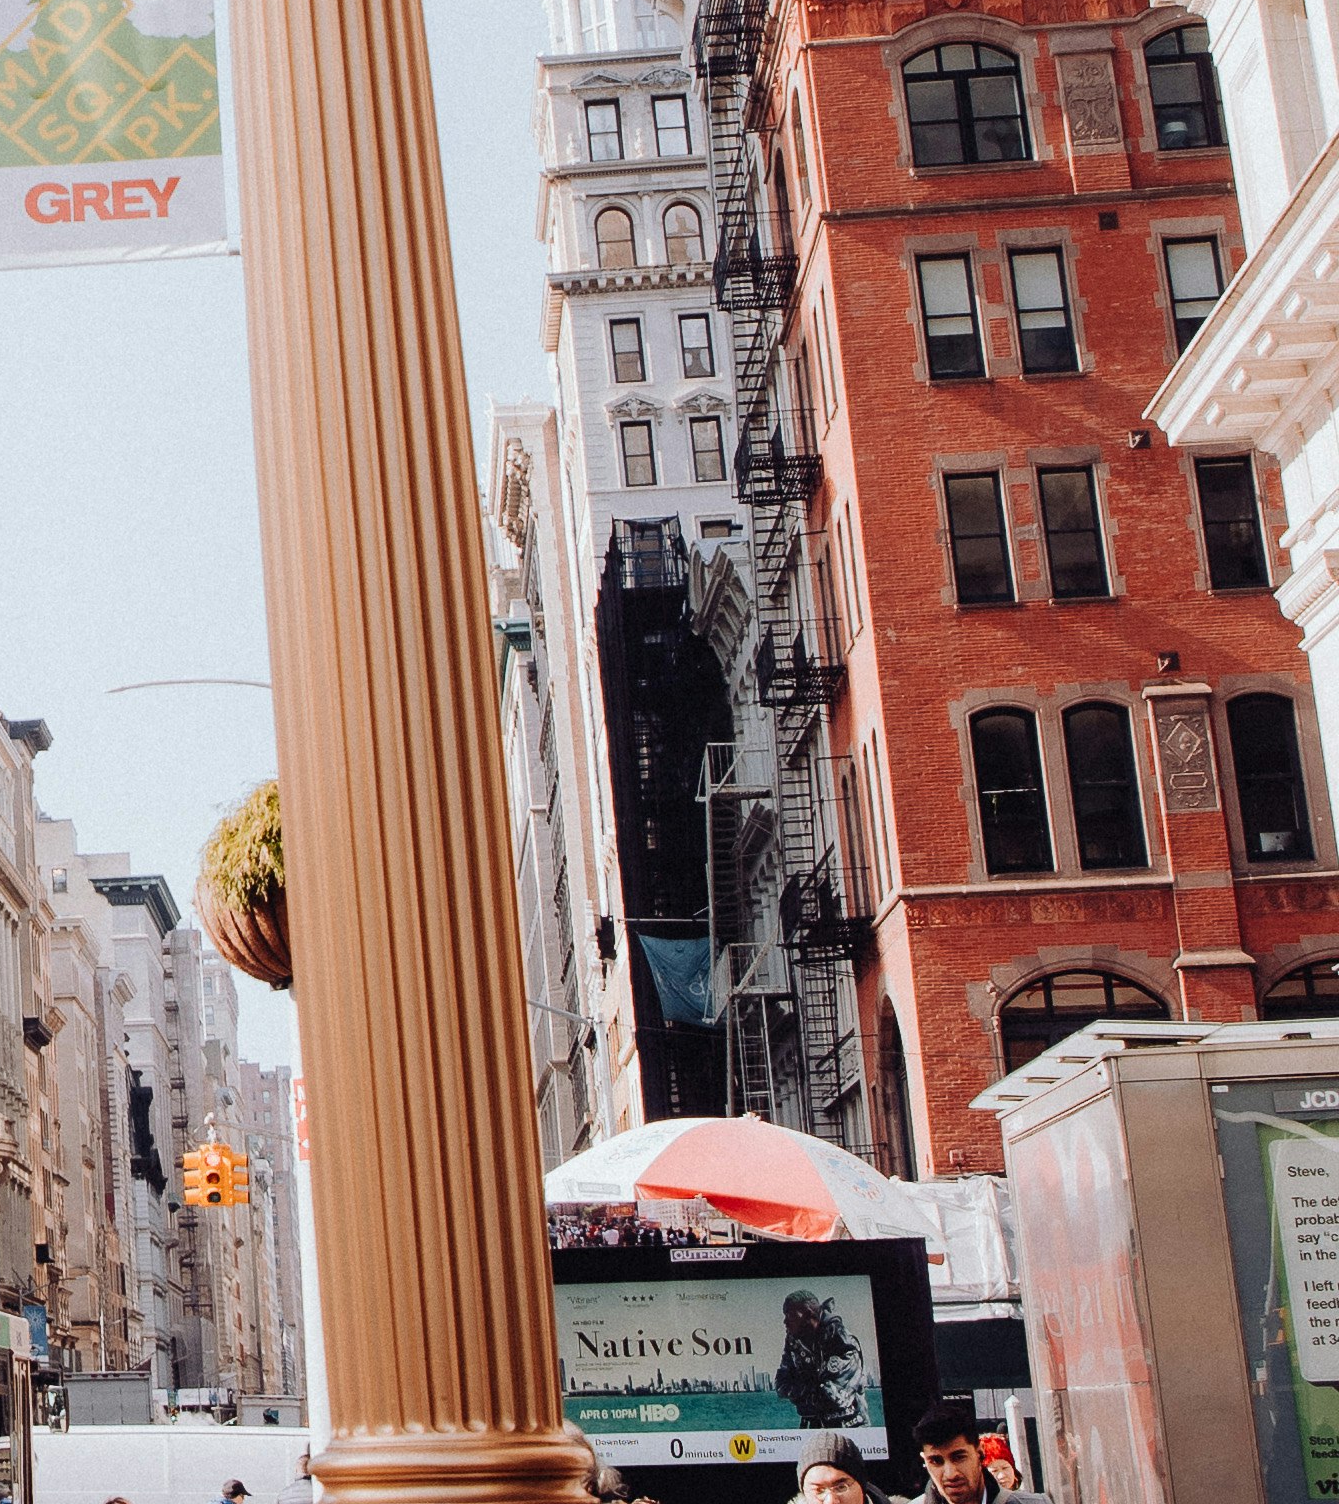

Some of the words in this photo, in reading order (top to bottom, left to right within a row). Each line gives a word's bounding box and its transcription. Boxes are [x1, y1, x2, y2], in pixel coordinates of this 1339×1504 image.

[37, 81, 127, 153] SQ.
[124, 82, 213, 157] PK.
[24, 176, 182, 225] GREY
[1287, 1165, 1330, 1179] Steve,
[1292, 1196, 1317, 1208] The
[1297, 1233, 1321, 1245] say
[673, 1249, 740, 1260] OUTFRONT
[1299, 1249, 1313, 1260] in
[1316, 1248, 1337, 1260] the
[1311, 1280, 1334, 1292] left
[1310, 1316, 1331, 1328] the
[574, 1329, 684, 1358] Native
[691, 1327, 754, 1356] Son
[1312, 1336, 1326, 1346] at
[579, 1410, 601, 1420] APR
[601, 1409, 609, 1419] 6
[611, 1408, 638, 1419] 10PM
[639, 1403, 680, 1422] HBO
[733, 1439, 751, 1455] W
[1309, 1436, 1335, 1447] Stop
[595, 1438, 639, 1446] Downtown
[670, 1438, 684, 1459] 0
[684, 1450, 724, 1459] minutes
[859, 1446, 888, 1455] nutes
